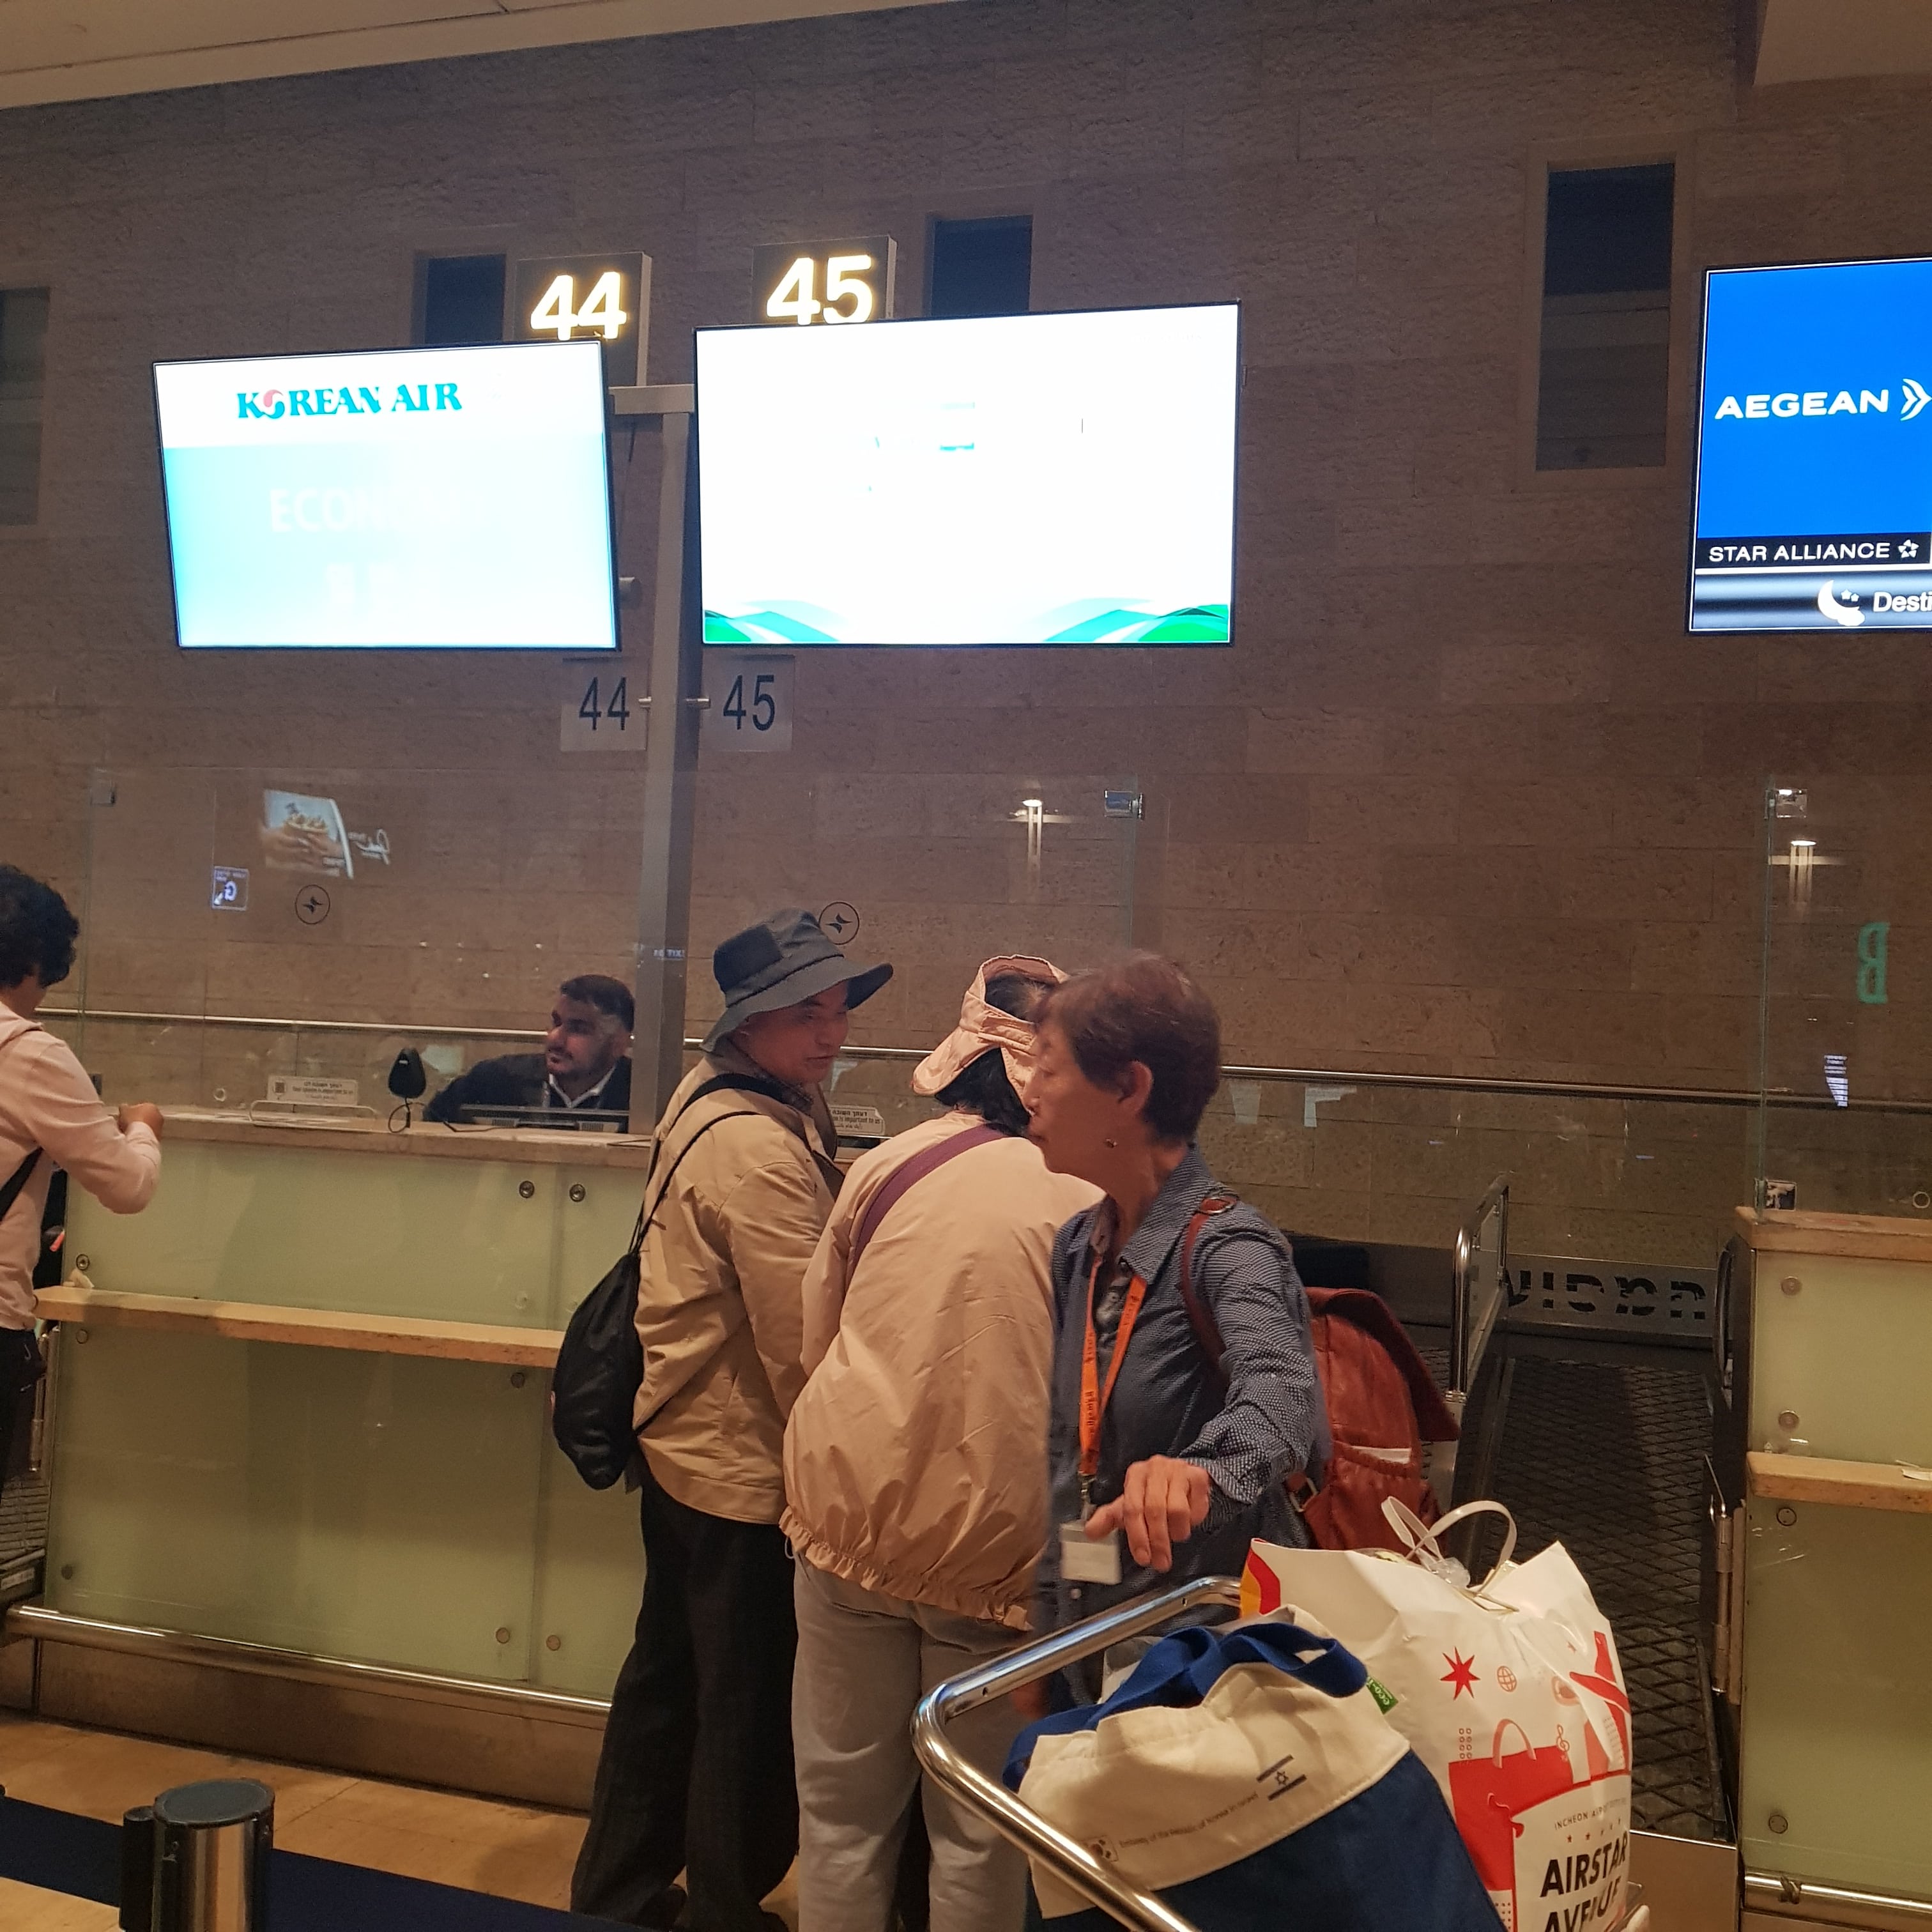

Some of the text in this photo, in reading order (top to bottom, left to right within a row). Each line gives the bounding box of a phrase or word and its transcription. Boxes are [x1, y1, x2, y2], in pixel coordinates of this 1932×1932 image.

[530, 271, 627, 341] 44
[766, 254, 873, 325] 45
[236, 383, 463, 419] KOREAN AIR
[1714, 389, 1889, 420] AEGEAN
[1709, 542, 1891, 562] STAR ALLIANCE
[578, 676, 631, 732] 44
[723, 674, 776, 732] 45
[1554, 1811, 1589, 1830] INCHEON
[1539, 1830, 1629, 1898] AIRSTAR
